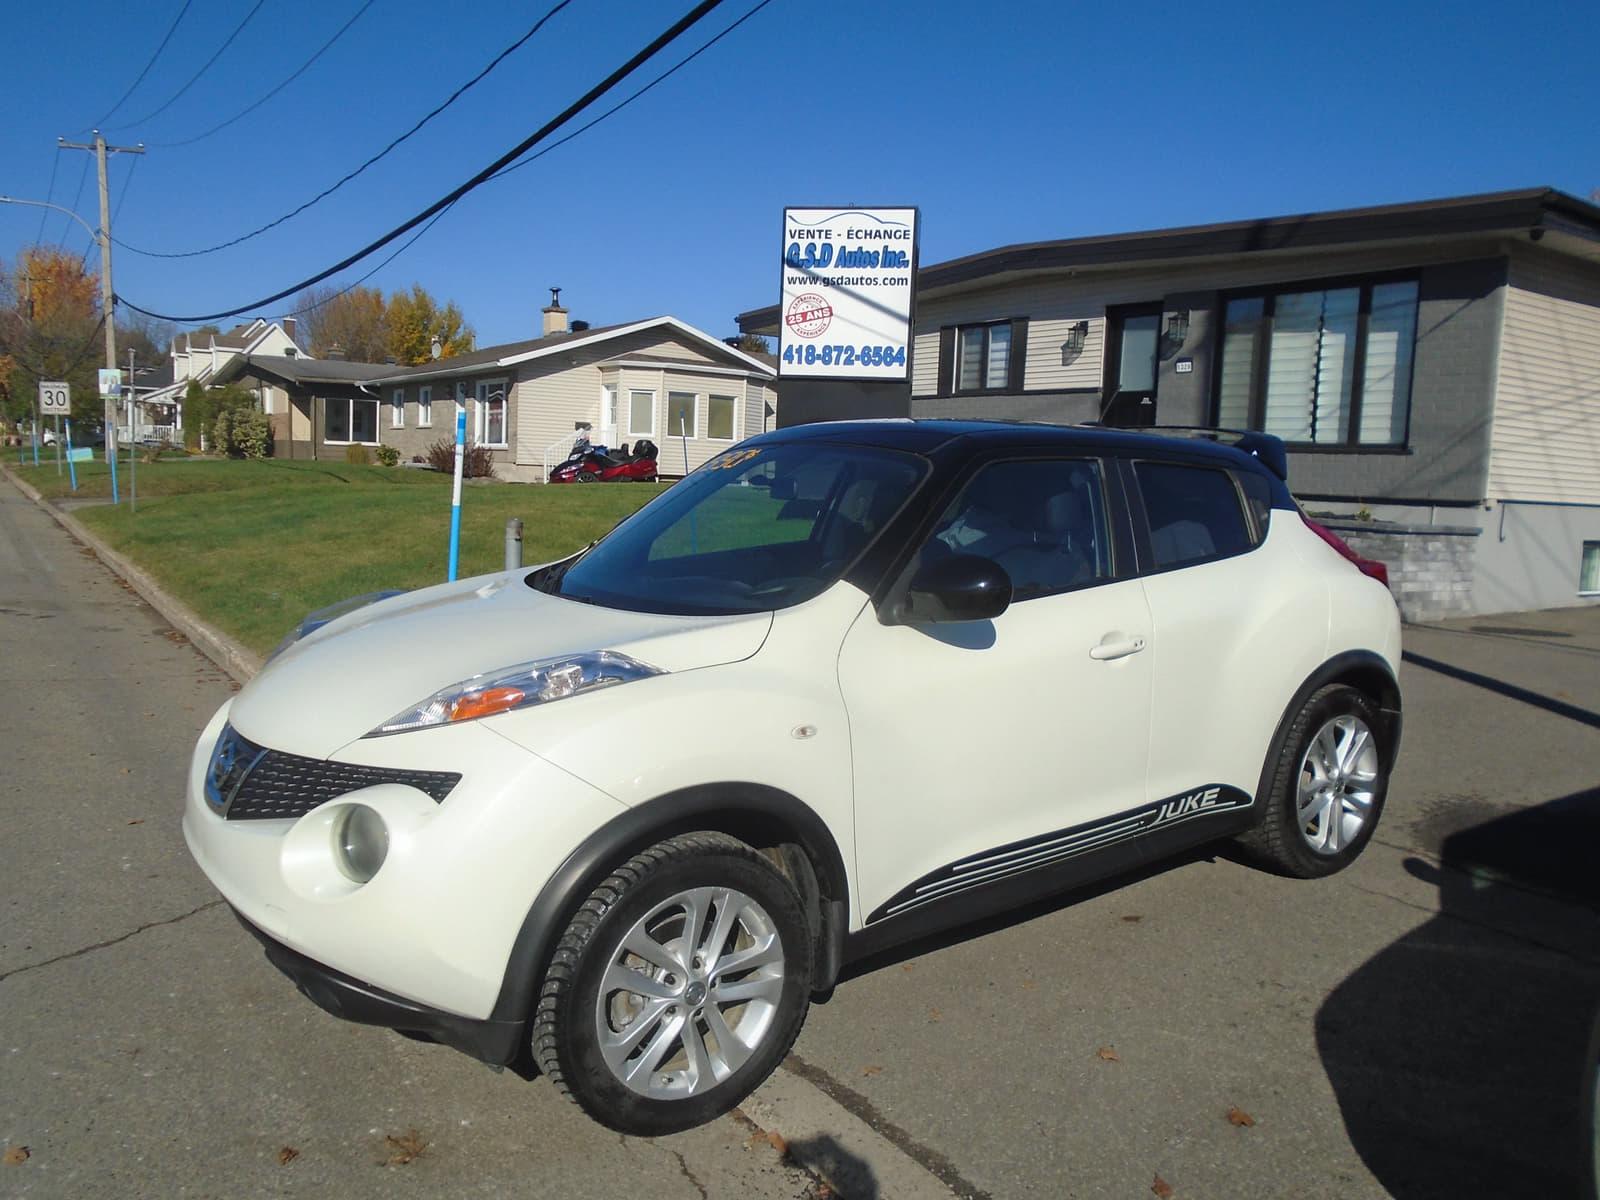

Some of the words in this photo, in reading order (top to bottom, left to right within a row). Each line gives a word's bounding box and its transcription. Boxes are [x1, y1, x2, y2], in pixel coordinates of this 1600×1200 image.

[789, 229, 832, 239] VENTE
[847, 226, 911, 239] ÉCHANGE
[834, 246, 880, 268] Autos
[881, 245, 910, 268] Inc.
[787, 275, 908, 287] www.gsdautos.com
[787, 313, 803, 324] 25
[806, 307, 831, 320] ANS
[782, 344, 905, 367] 418-872-6564
[44, 390, 66, 406] 30
[1148, 787, 1220, 826] JUKE
